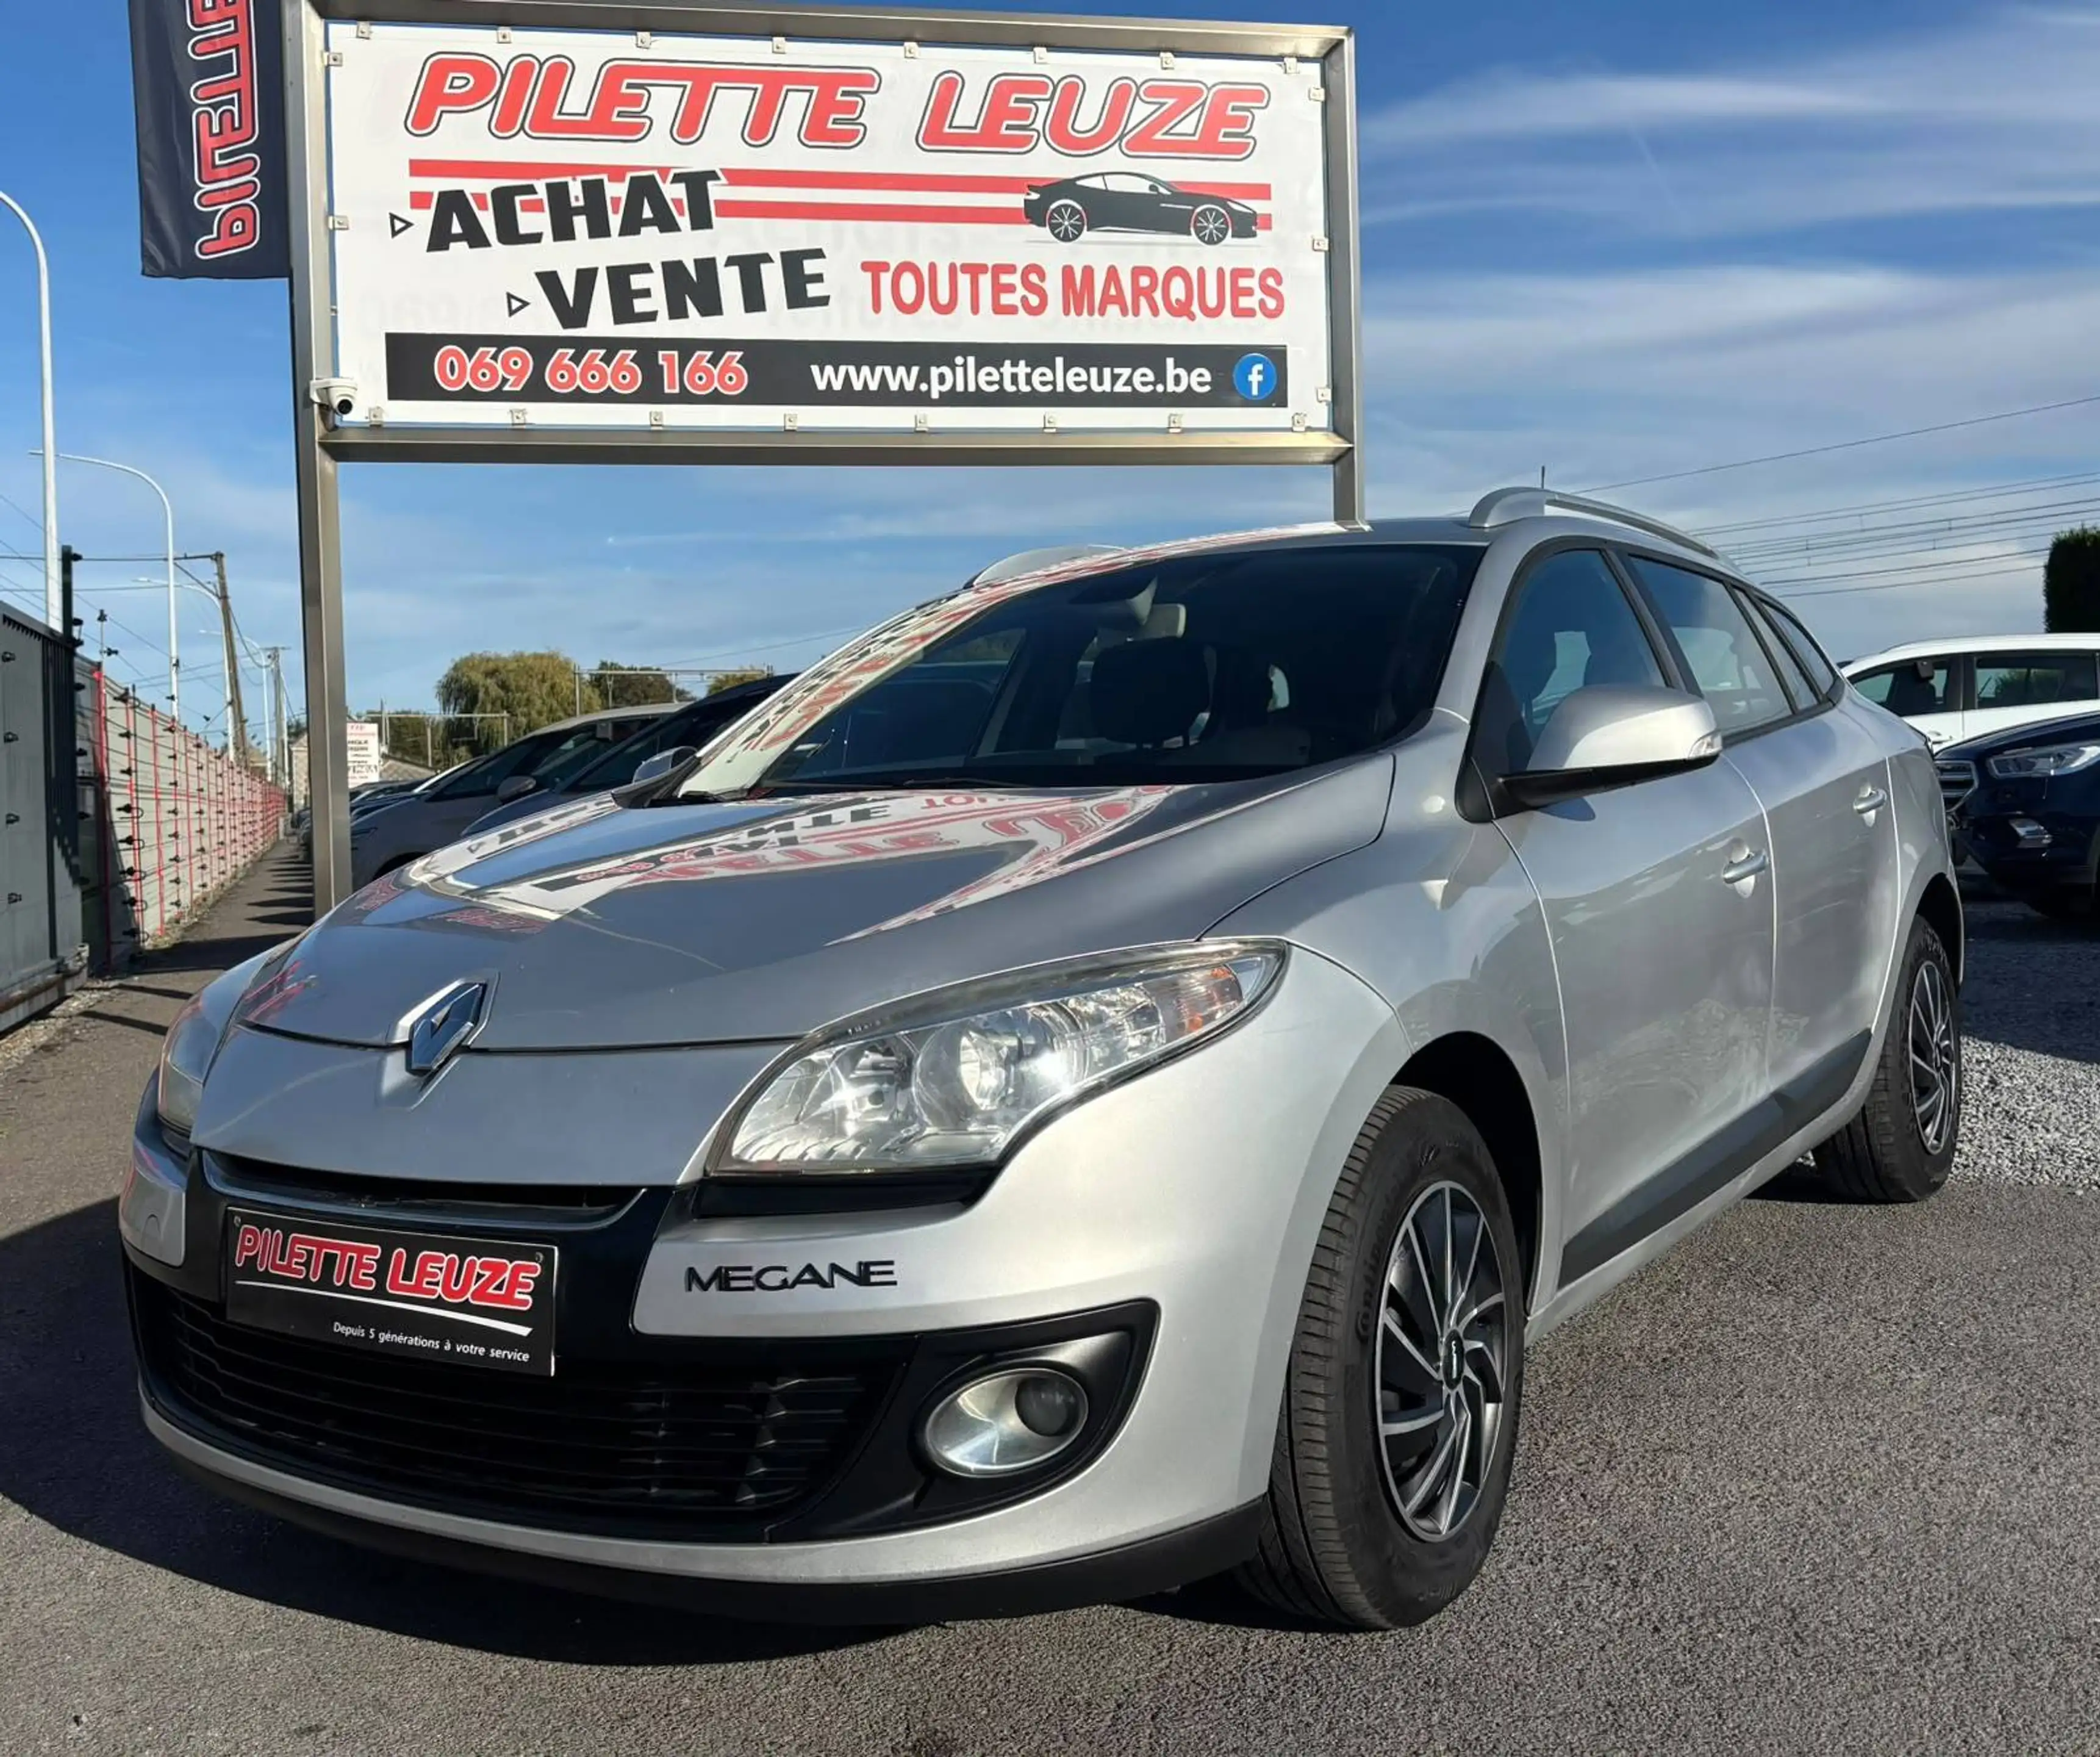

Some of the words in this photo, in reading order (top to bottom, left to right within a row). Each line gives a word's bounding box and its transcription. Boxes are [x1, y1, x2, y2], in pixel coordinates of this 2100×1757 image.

[404, 51, 881, 148] PILETTE
[916, 70, 1270, 161] LEUZE
[426, 169, 723, 253] ACHAT
[534, 248, 831, 329] VENTE
[861, 260, 1048, 317] TOUTES
[1061, 264, 1285, 322] MARQUES
[434, 345, 534, 392] 069
[545, 348, 642, 394] 666
[658, 351, 748, 395] 166
[811, 356, 1212, 399] www.piletteleuze.be
[235, 1224, 381, 1291] PILETTE
[386, 1248, 541, 1310] LEUZE
[684, 1259, 898, 1292] MEGANE
[333, 1321, 365, 1337] Depuis
[369, 1328, 375, 1339] 5
[378, 1331, 440, 1350] générations
[444, 1337, 451, 1351] à
[456, 1343, 486, 1356] votre
[489, 1347, 530, 1362] service
